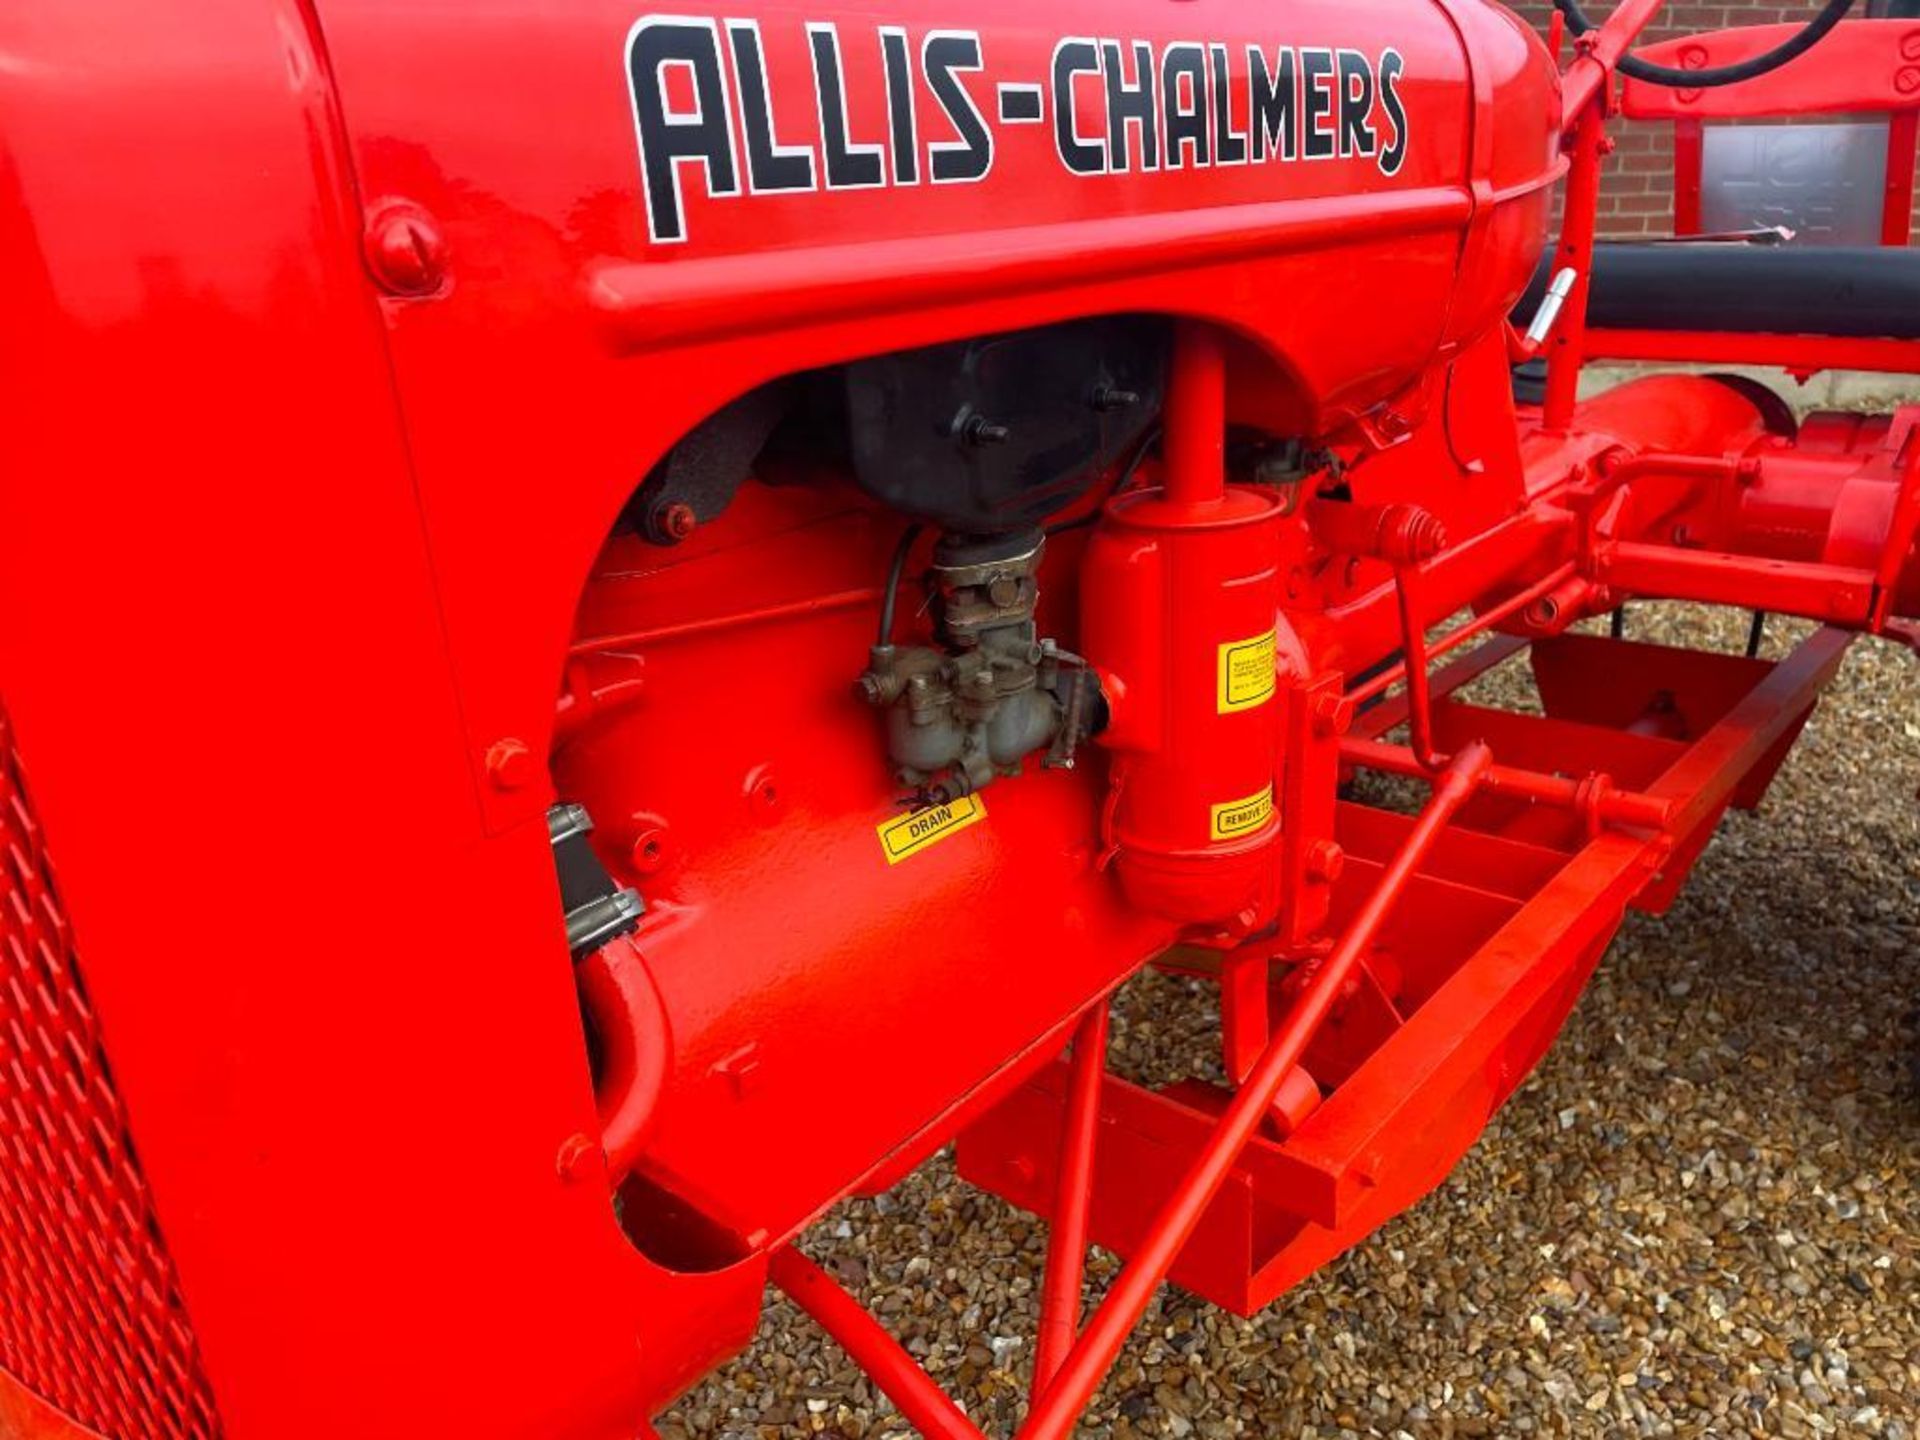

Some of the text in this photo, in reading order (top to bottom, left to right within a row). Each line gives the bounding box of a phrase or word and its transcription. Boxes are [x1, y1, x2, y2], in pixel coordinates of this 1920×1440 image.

[624, 14, 1407, 243] ALLIS-CHALMERS
[908, 807, 953, 838] DRAIN
[1225, 807, 1260, 826] REMOVE
